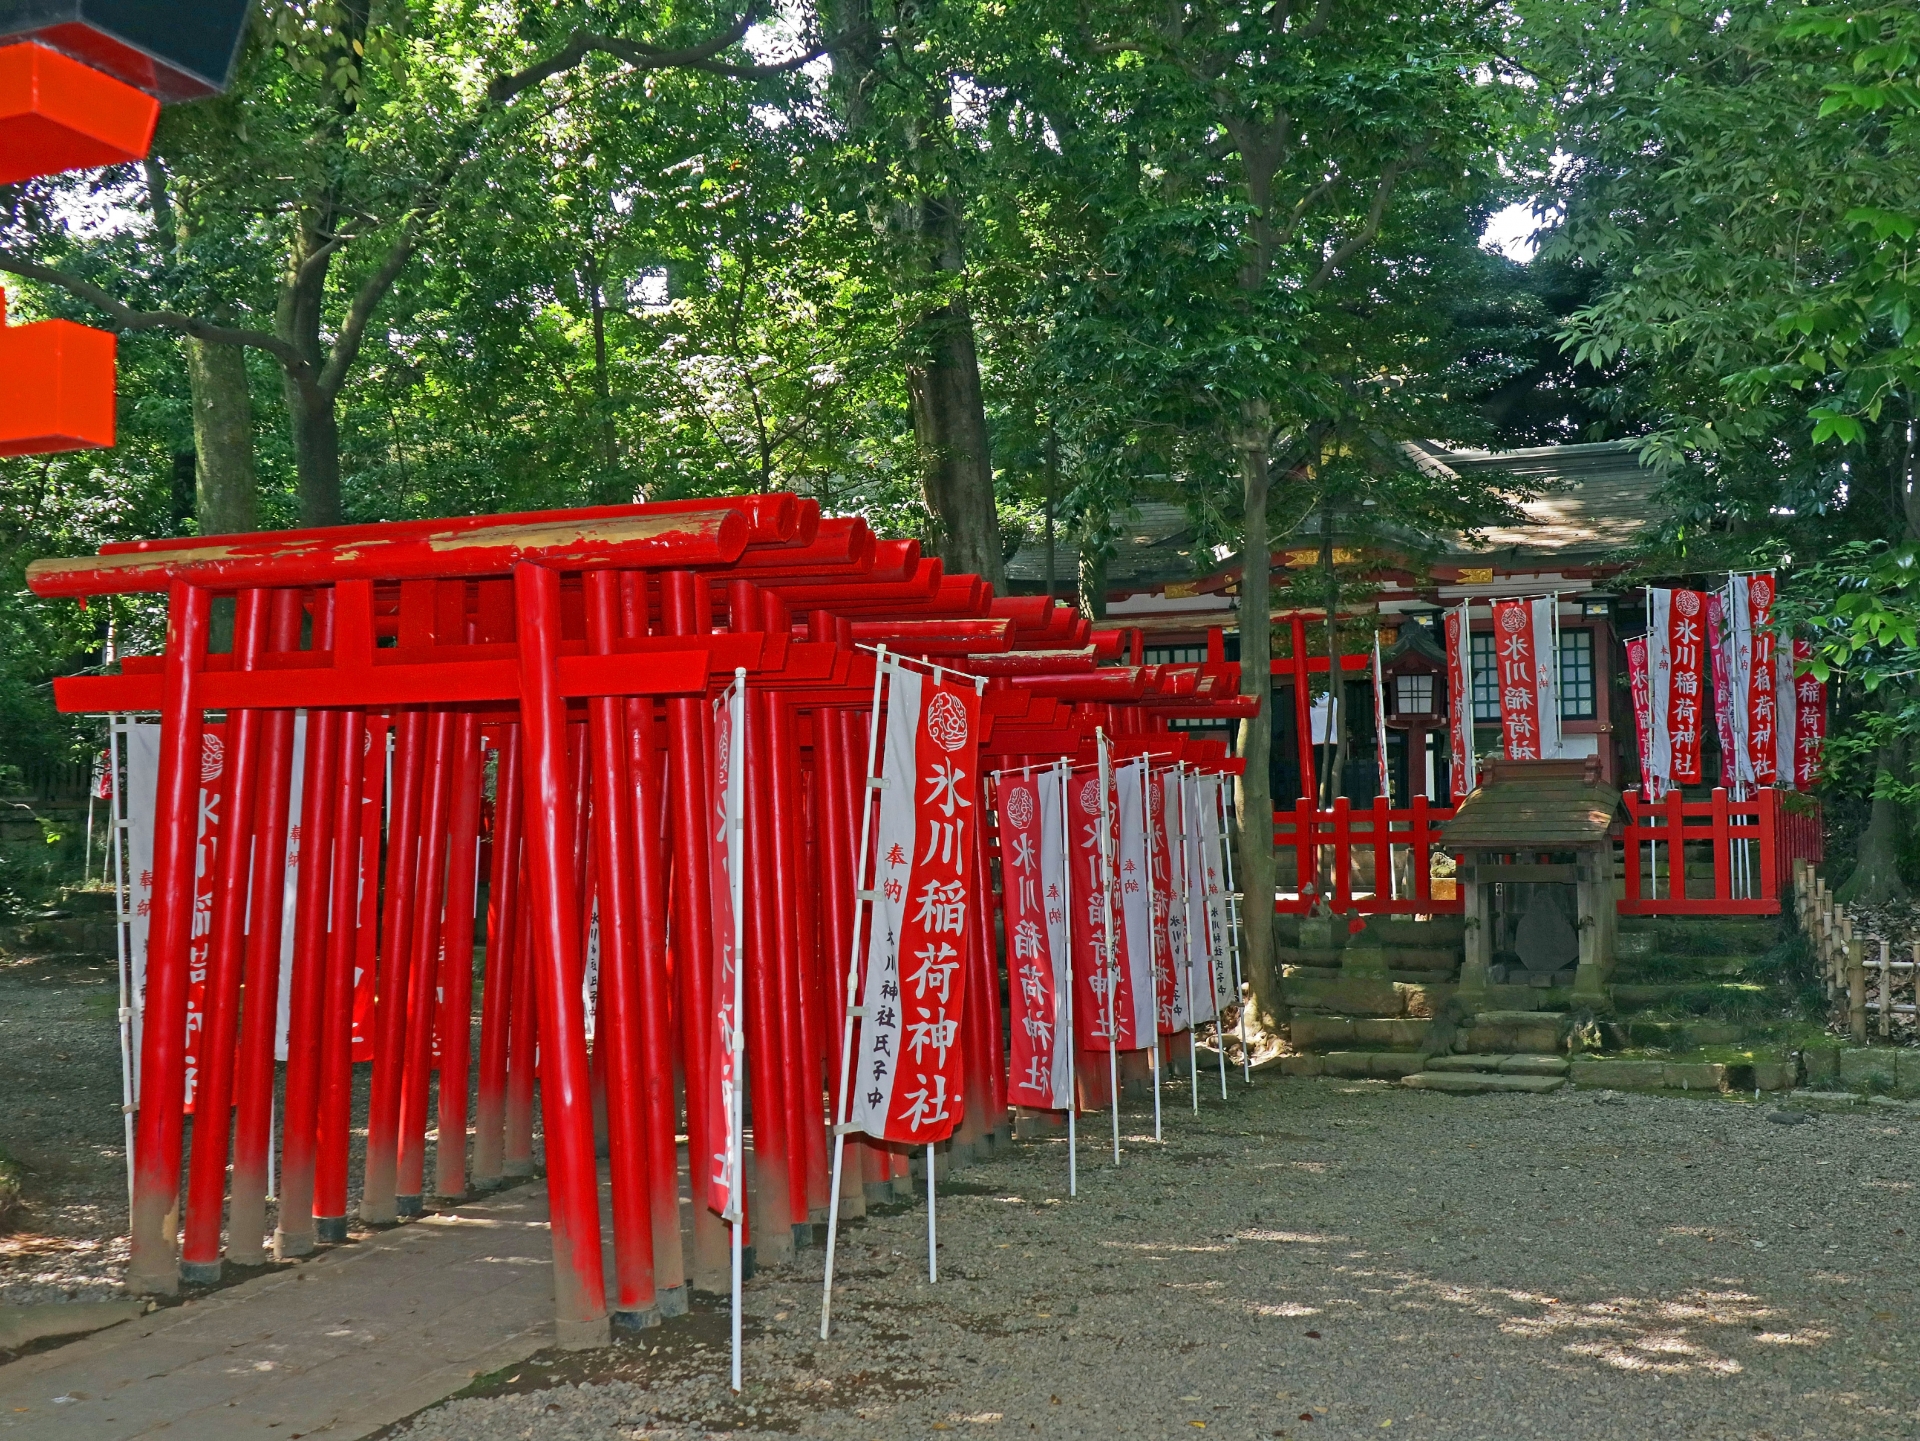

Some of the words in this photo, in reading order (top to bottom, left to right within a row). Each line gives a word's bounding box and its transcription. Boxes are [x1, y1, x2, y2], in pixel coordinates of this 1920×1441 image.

[1671, 618, 1701, 776] 氷川稲荷神社
[1753, 610, 1776, 779] 氷川稲荷神社
[884, 843, 908, 904] 奉納
[897, 756, 972, 1132] 氷川稲荷神社
